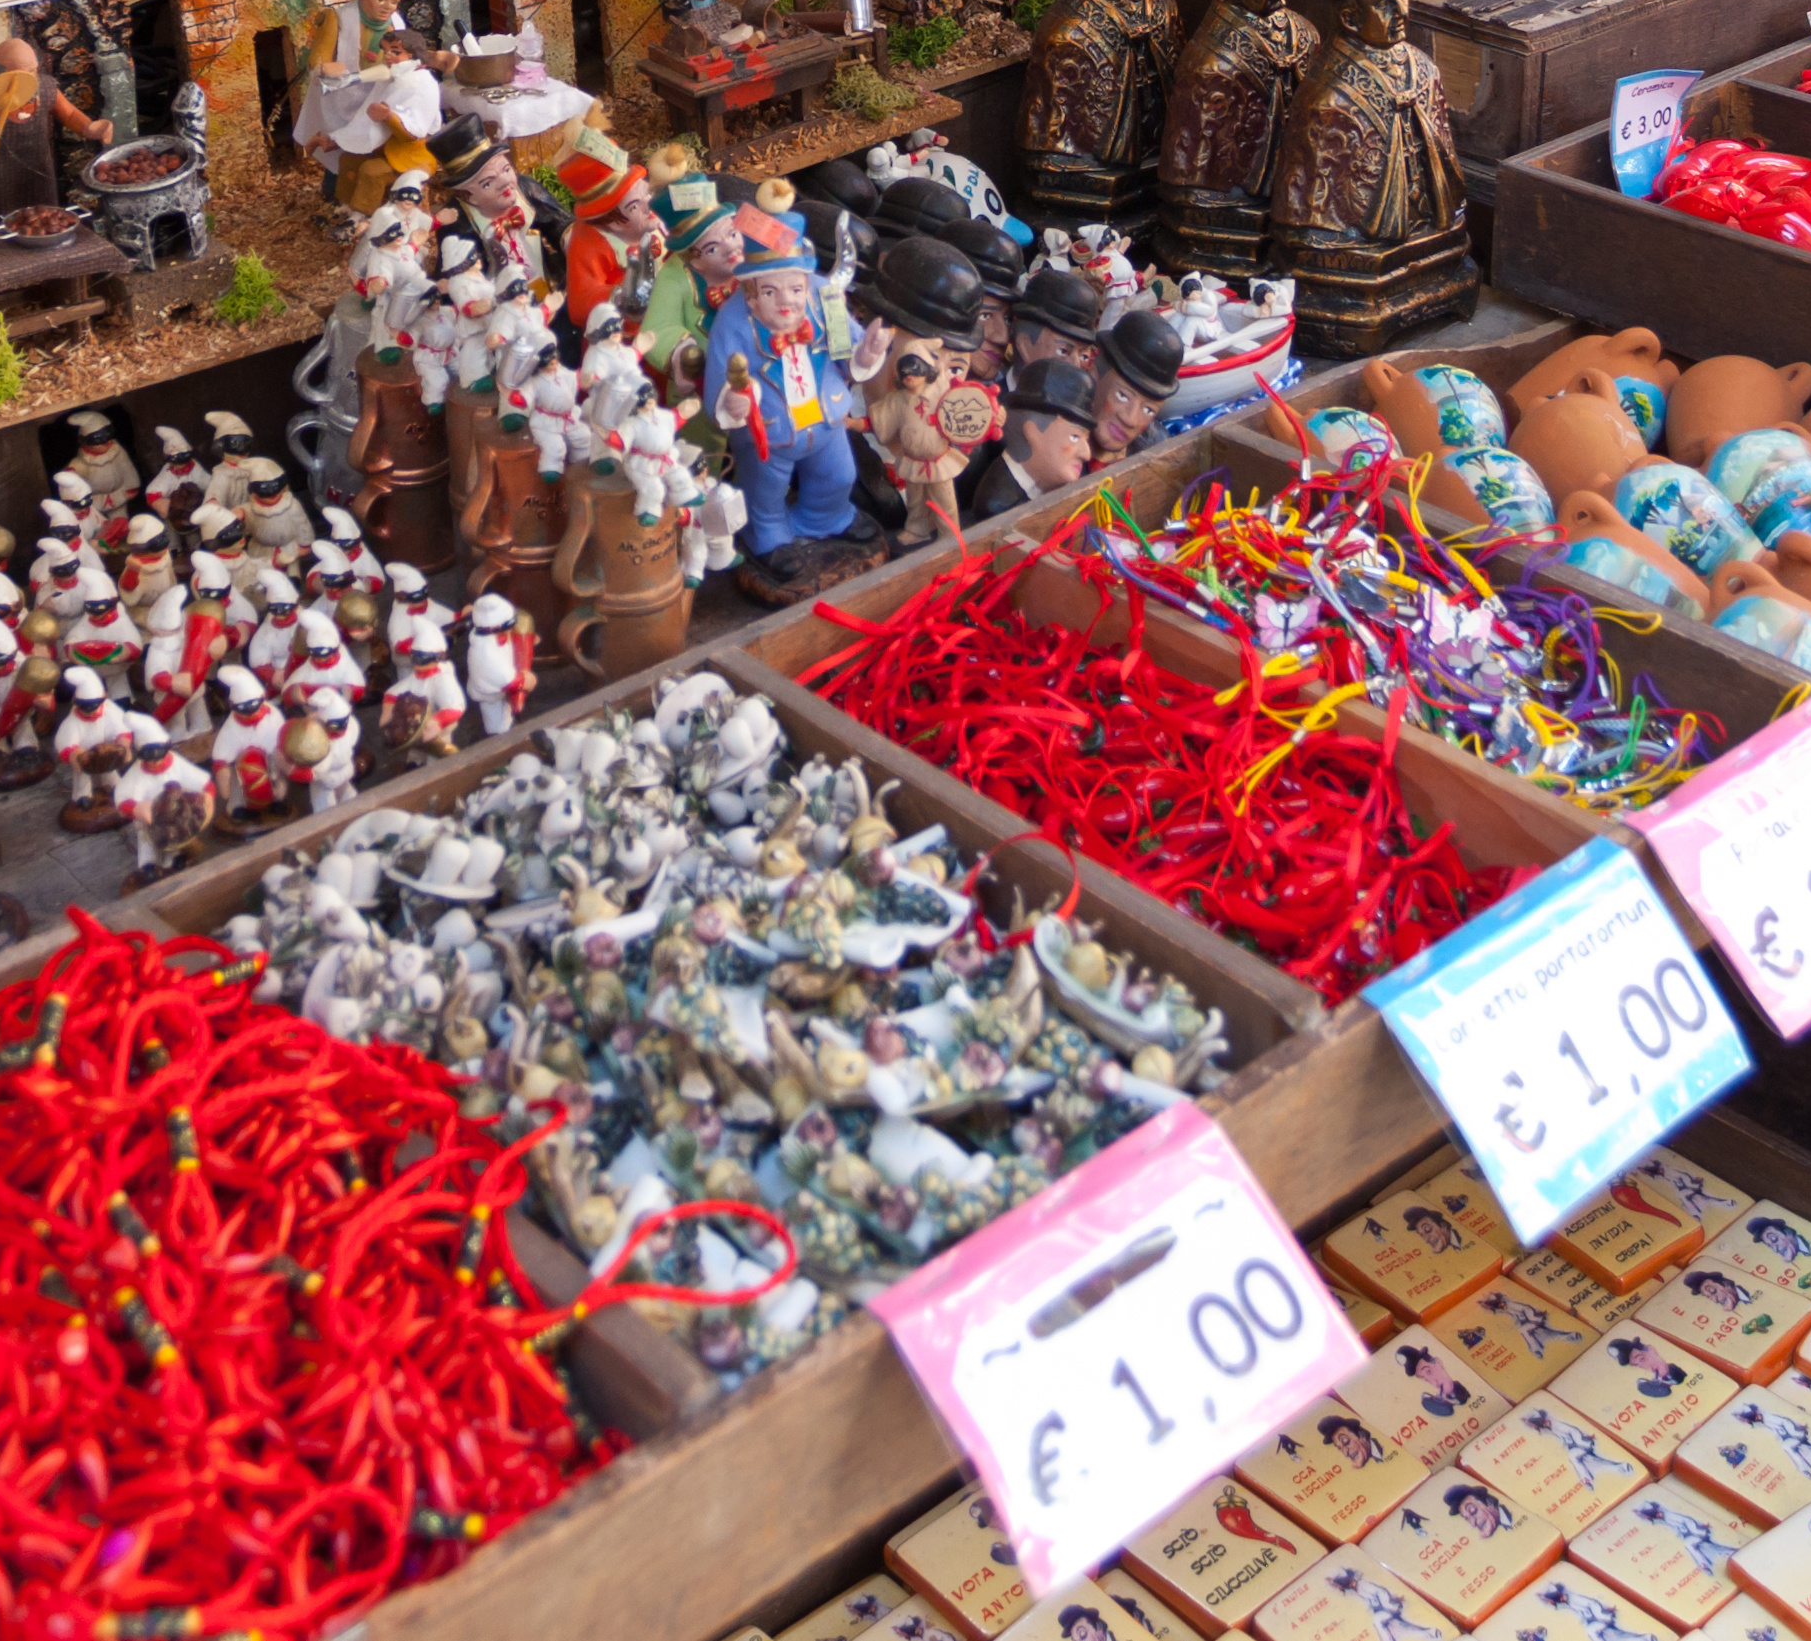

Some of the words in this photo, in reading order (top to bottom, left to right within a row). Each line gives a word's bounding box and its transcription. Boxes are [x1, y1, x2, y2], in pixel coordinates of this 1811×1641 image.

[1631, 81, 1675, 99] Ceramica
[1621, 123, 1632, 141] €
[1638, 106, 1674, 137] 3,00
[1748, 905, 1806, 980] €
[1493, 1069, 1549, 1155] €
[1557, 957, 1709, 1108] 1,00
[1563, 1200, 1618, 1238] ASSISTIMI
[1588, 1220, 1634, 1251] INVIDIA
[1373, 1248, 1422, 1279] NISCIUNO
[1614, 1233, 1655, 1264] CREPA!
[1732, 1252, 1745, 1265] E
[1406, 1273, 1443, 1300] FESSO
[1671, 1304, 1686, 1318] E
[1691, 1313, 1710, 1331] IO
[1028, 1409, 1067, 1506] €
[1110, 1256, 1305, 1446] 1,00
[1390, 1415, 1429, 1448] VOTA
[1608, 1399, 1647, 1433] VOTA
[1640, 1393, 1700, 1448] ANTONIO
[1419, 1416, 1481, 1468] ANTONIO
[1293, 1462, 1344, 1505] NISCIUNO
[1330, 1493, 1368, 1526] FESSO
[1420, 1535, 1471, 1582] NISCIUNO
[951, 1566, 996, 1602] VOTA
[1458, 1564, 1498, 1600] FESSO
[980, 1582, 1026, 1622] ANTO
